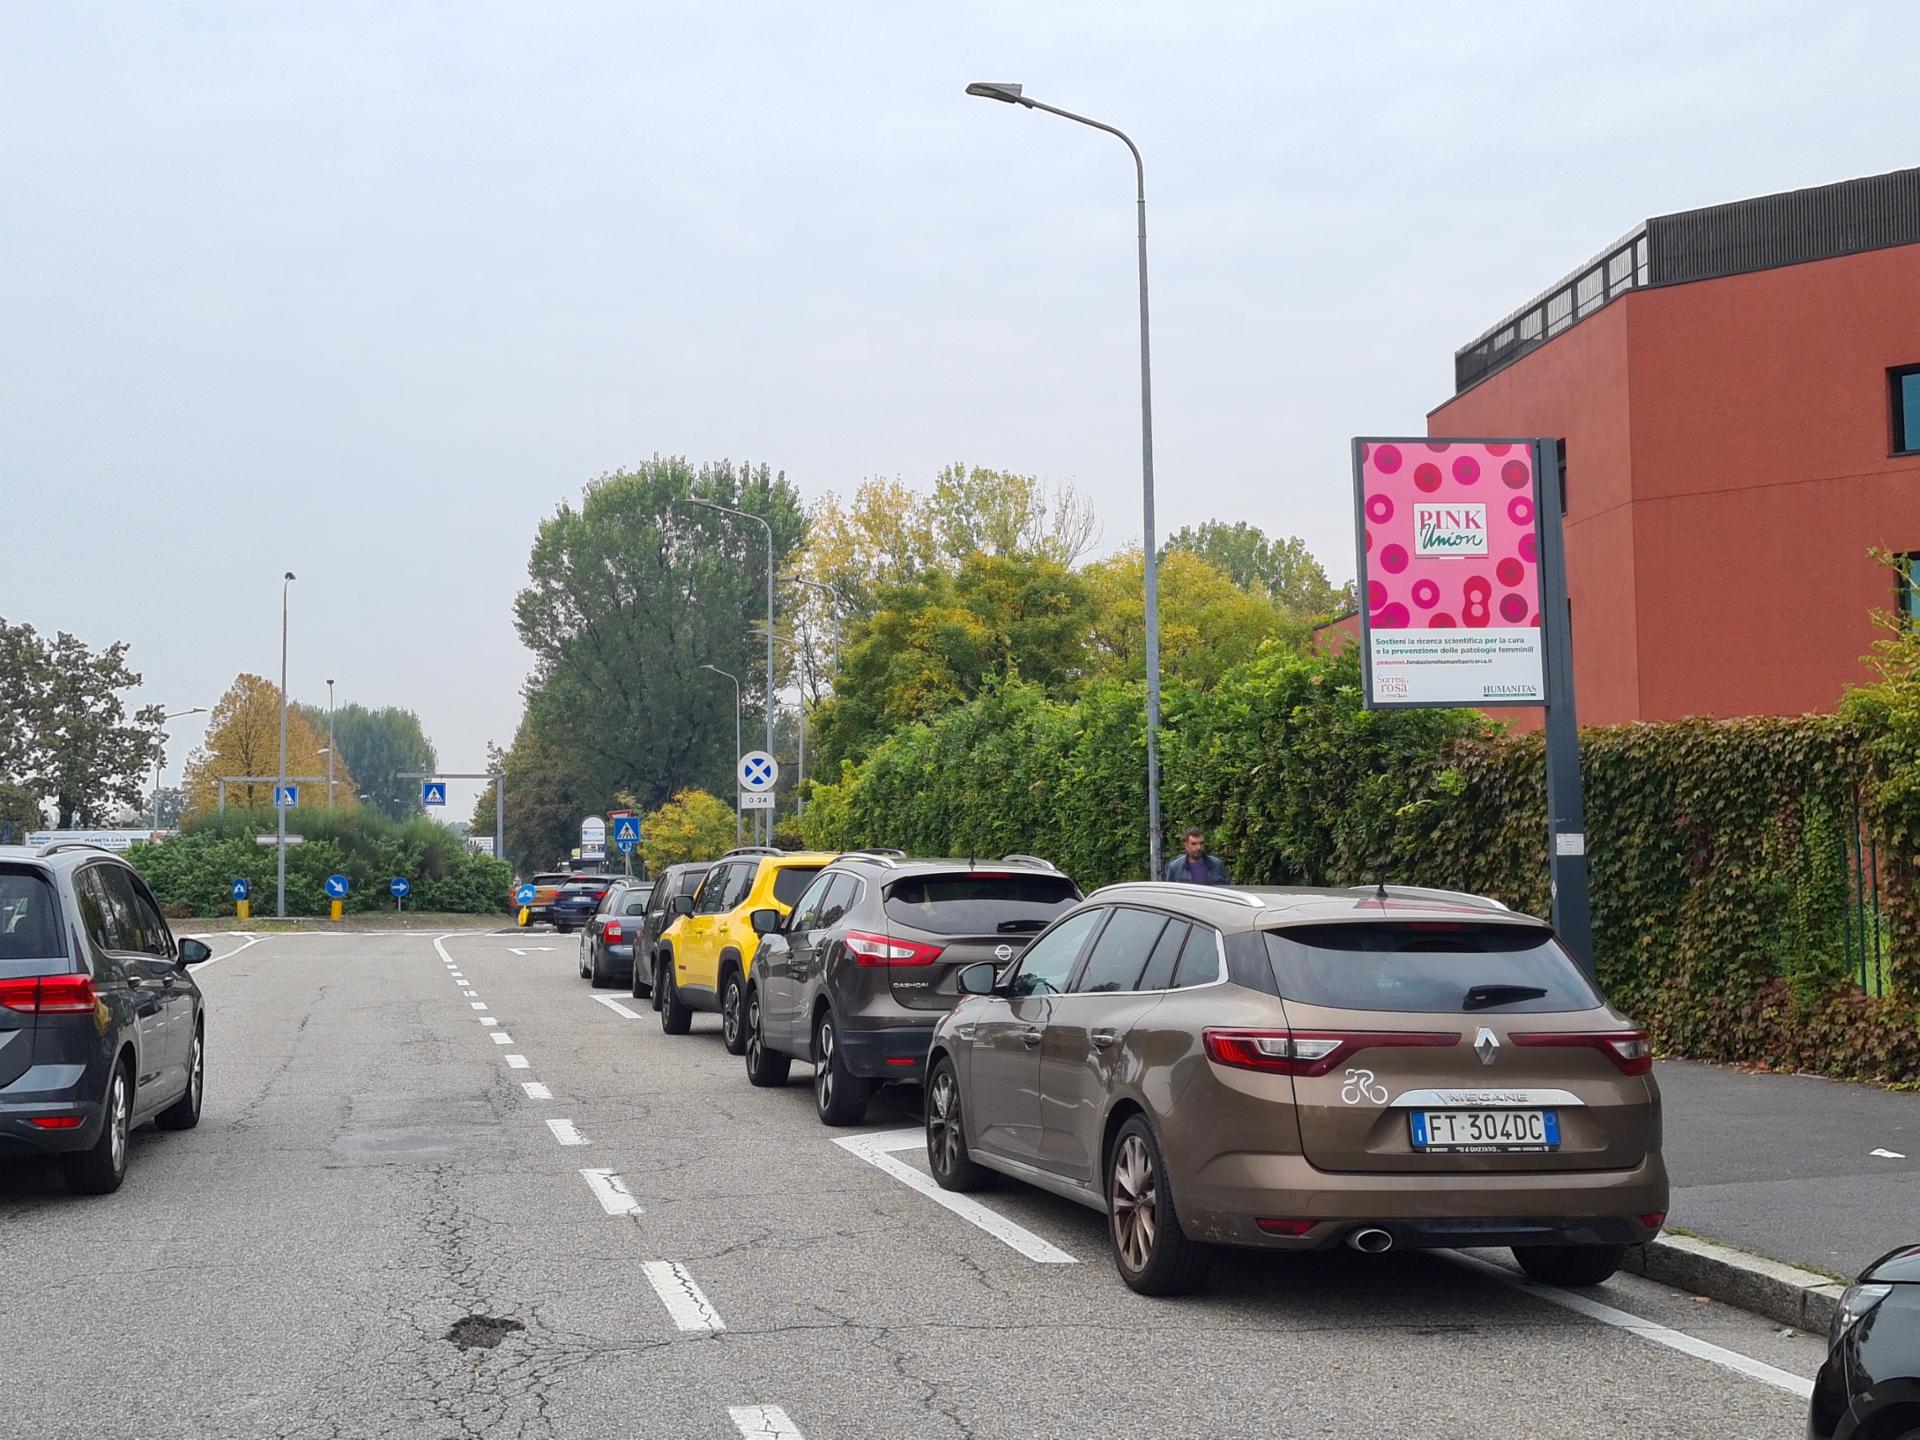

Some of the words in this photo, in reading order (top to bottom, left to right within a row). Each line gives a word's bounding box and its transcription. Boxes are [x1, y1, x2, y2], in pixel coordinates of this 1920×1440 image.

[1419, 510, 1484, 530] PINK
[1420, 523, 1483, 549] Union
[1444, 637, 1483, 645] scientifica
[1391, 648, 1439, 656] prevenzione
[1460, 646, 1496, 655] patologie
[1381, 683, 1407, 693] rosa
[1483, 684, 1537, 694] HUMANITAS
[1449, 1093, 1529, 1102] MEGANE
[1429, 1115, 1457, 1142] FT
[1468, 1114, 1543, 1141] 304DC
